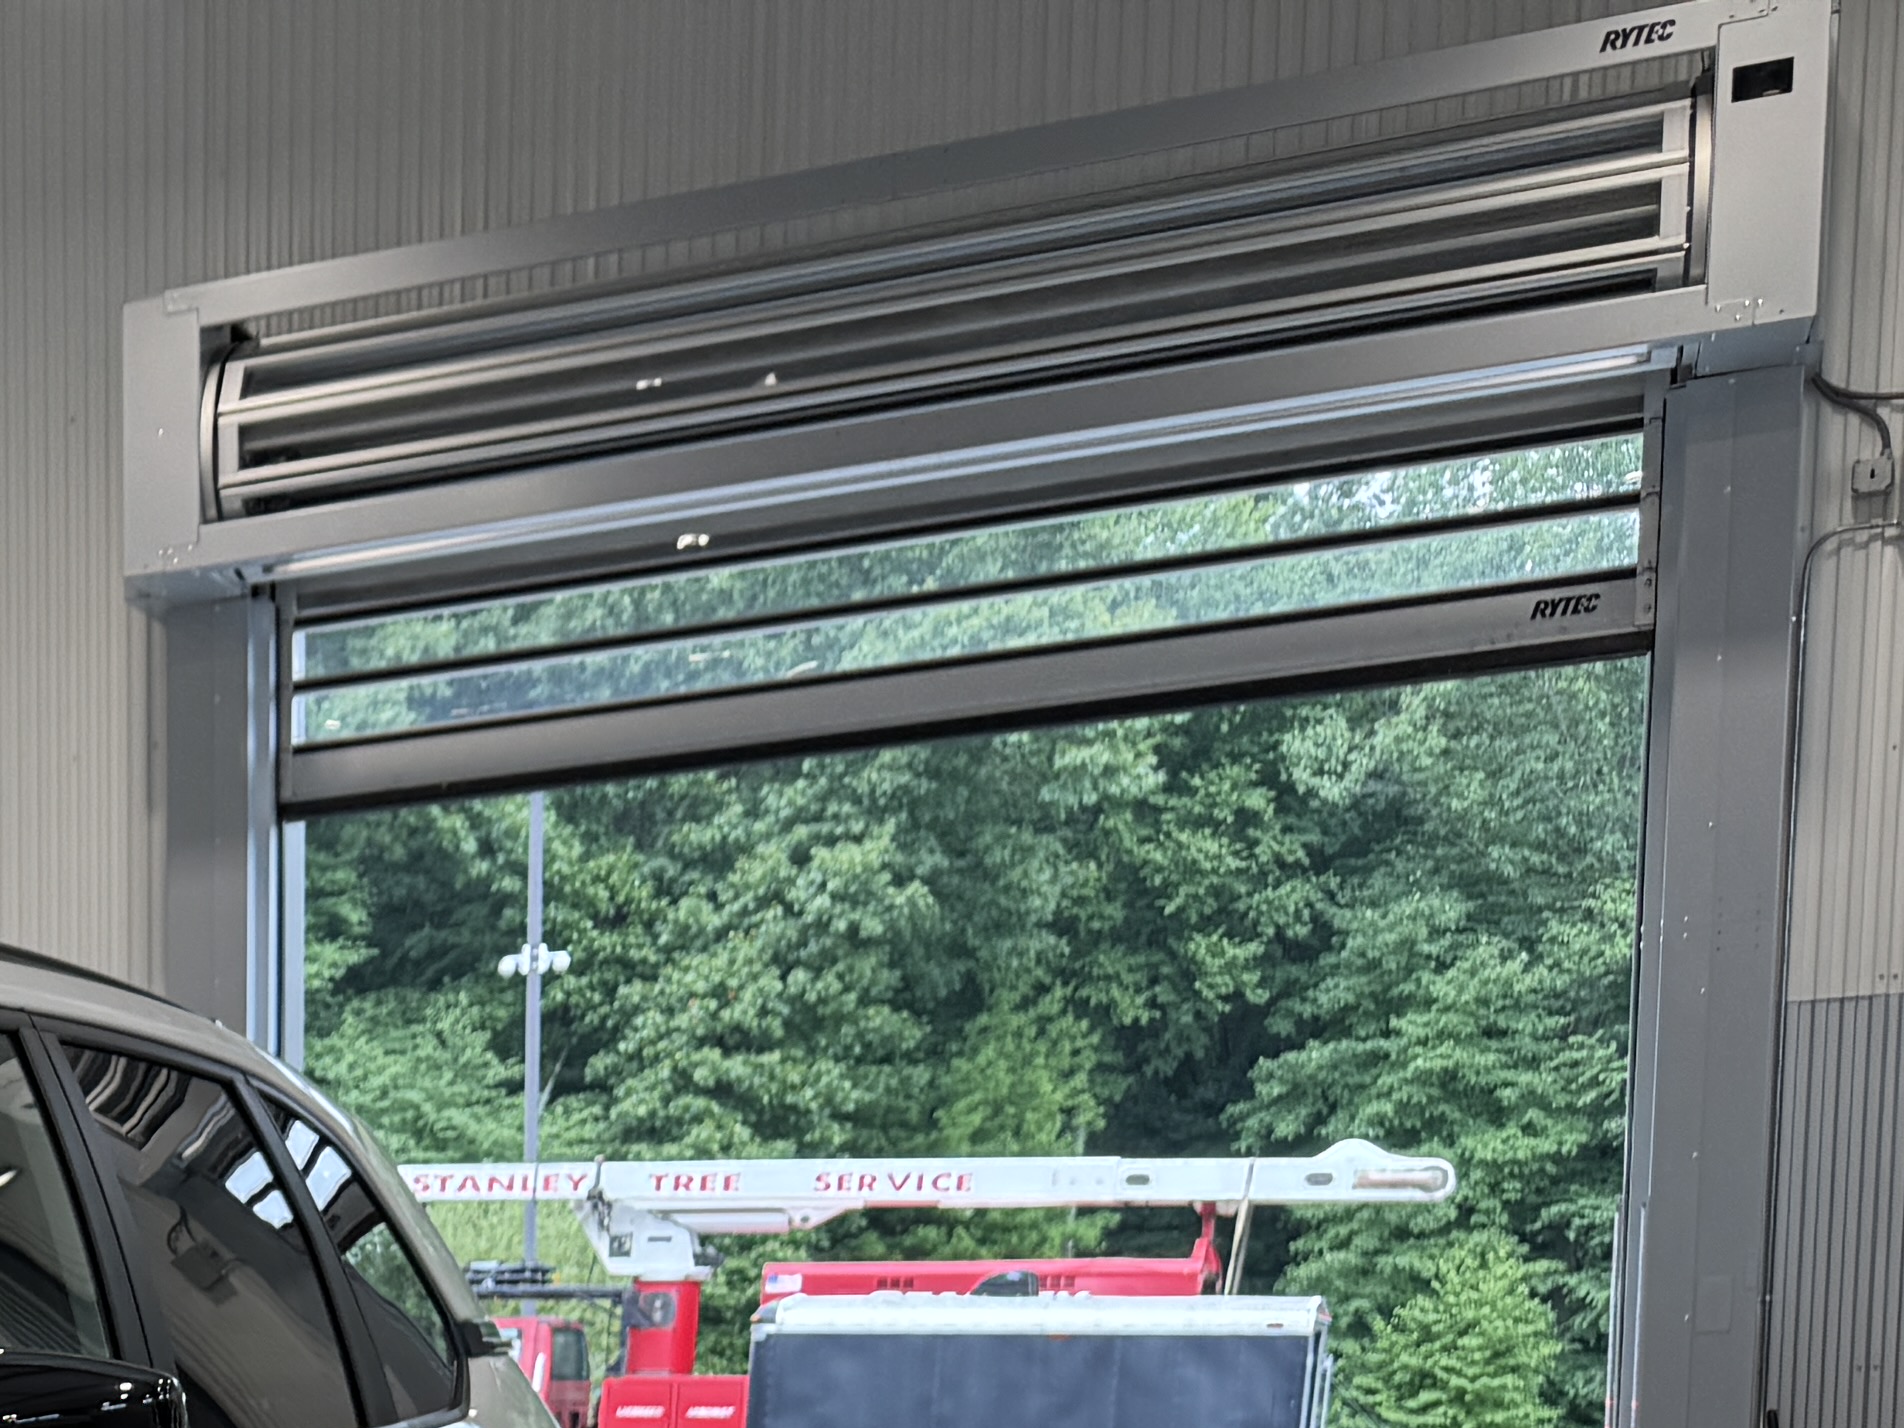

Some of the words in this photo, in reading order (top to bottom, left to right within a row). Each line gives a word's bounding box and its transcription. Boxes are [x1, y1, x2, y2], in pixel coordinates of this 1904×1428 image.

[1599, 19, 1676, 53] RYTEC
[1530, 593, 1600, 621] RYTEC
[414, 1174, 587, 1194] STANLEY
[650, 1174, 742, 1193] TREE
[813, 1173, 974, 1194] SERVICE
